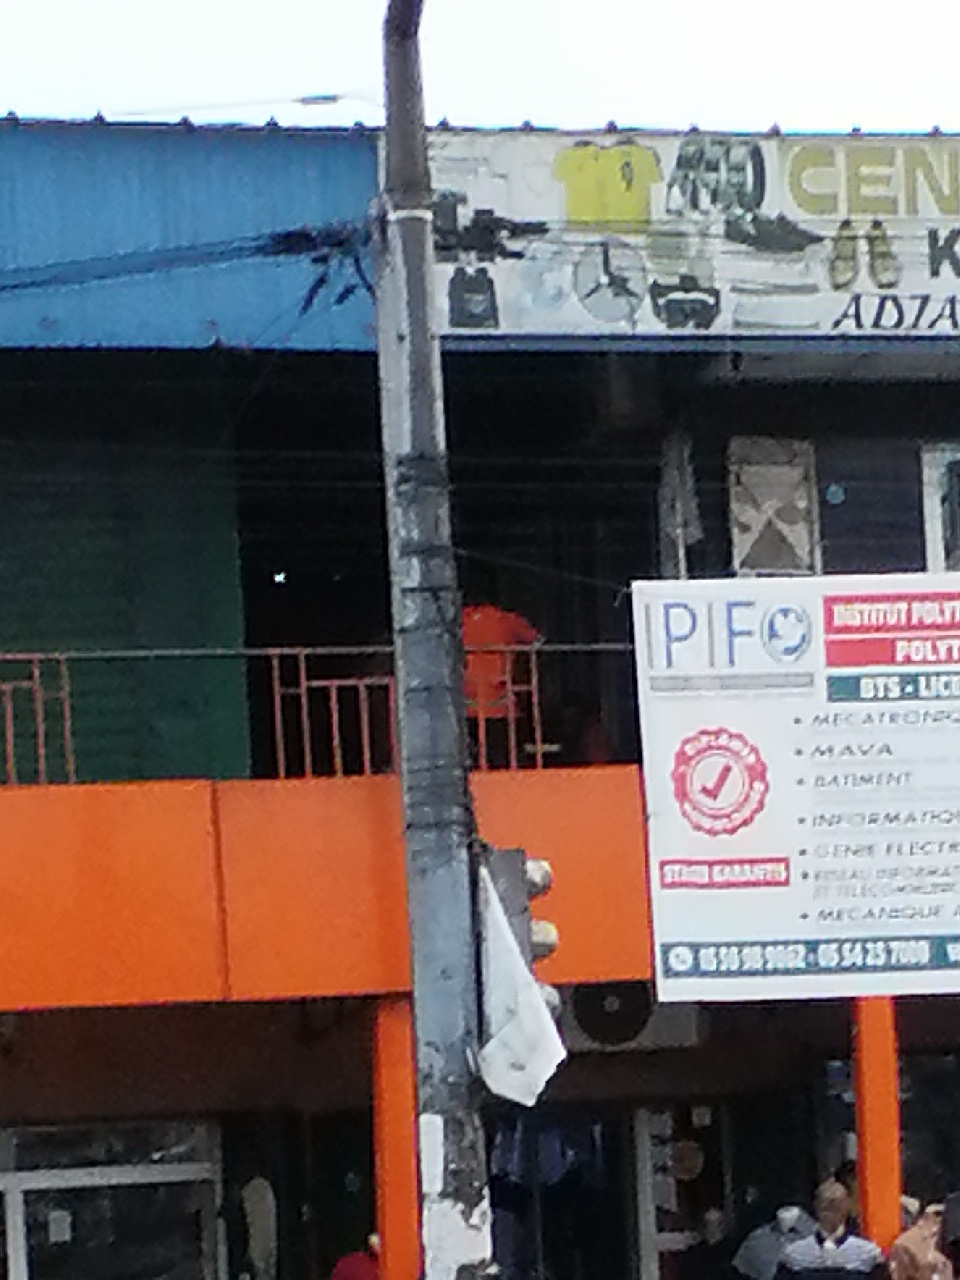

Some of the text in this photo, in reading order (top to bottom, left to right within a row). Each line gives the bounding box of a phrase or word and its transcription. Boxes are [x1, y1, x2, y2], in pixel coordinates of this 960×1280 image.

[832, 602, 908, 627] INSTITUT
[859, 675, 901, 699] BTS
[811, 742, 894, 757] MAVA
